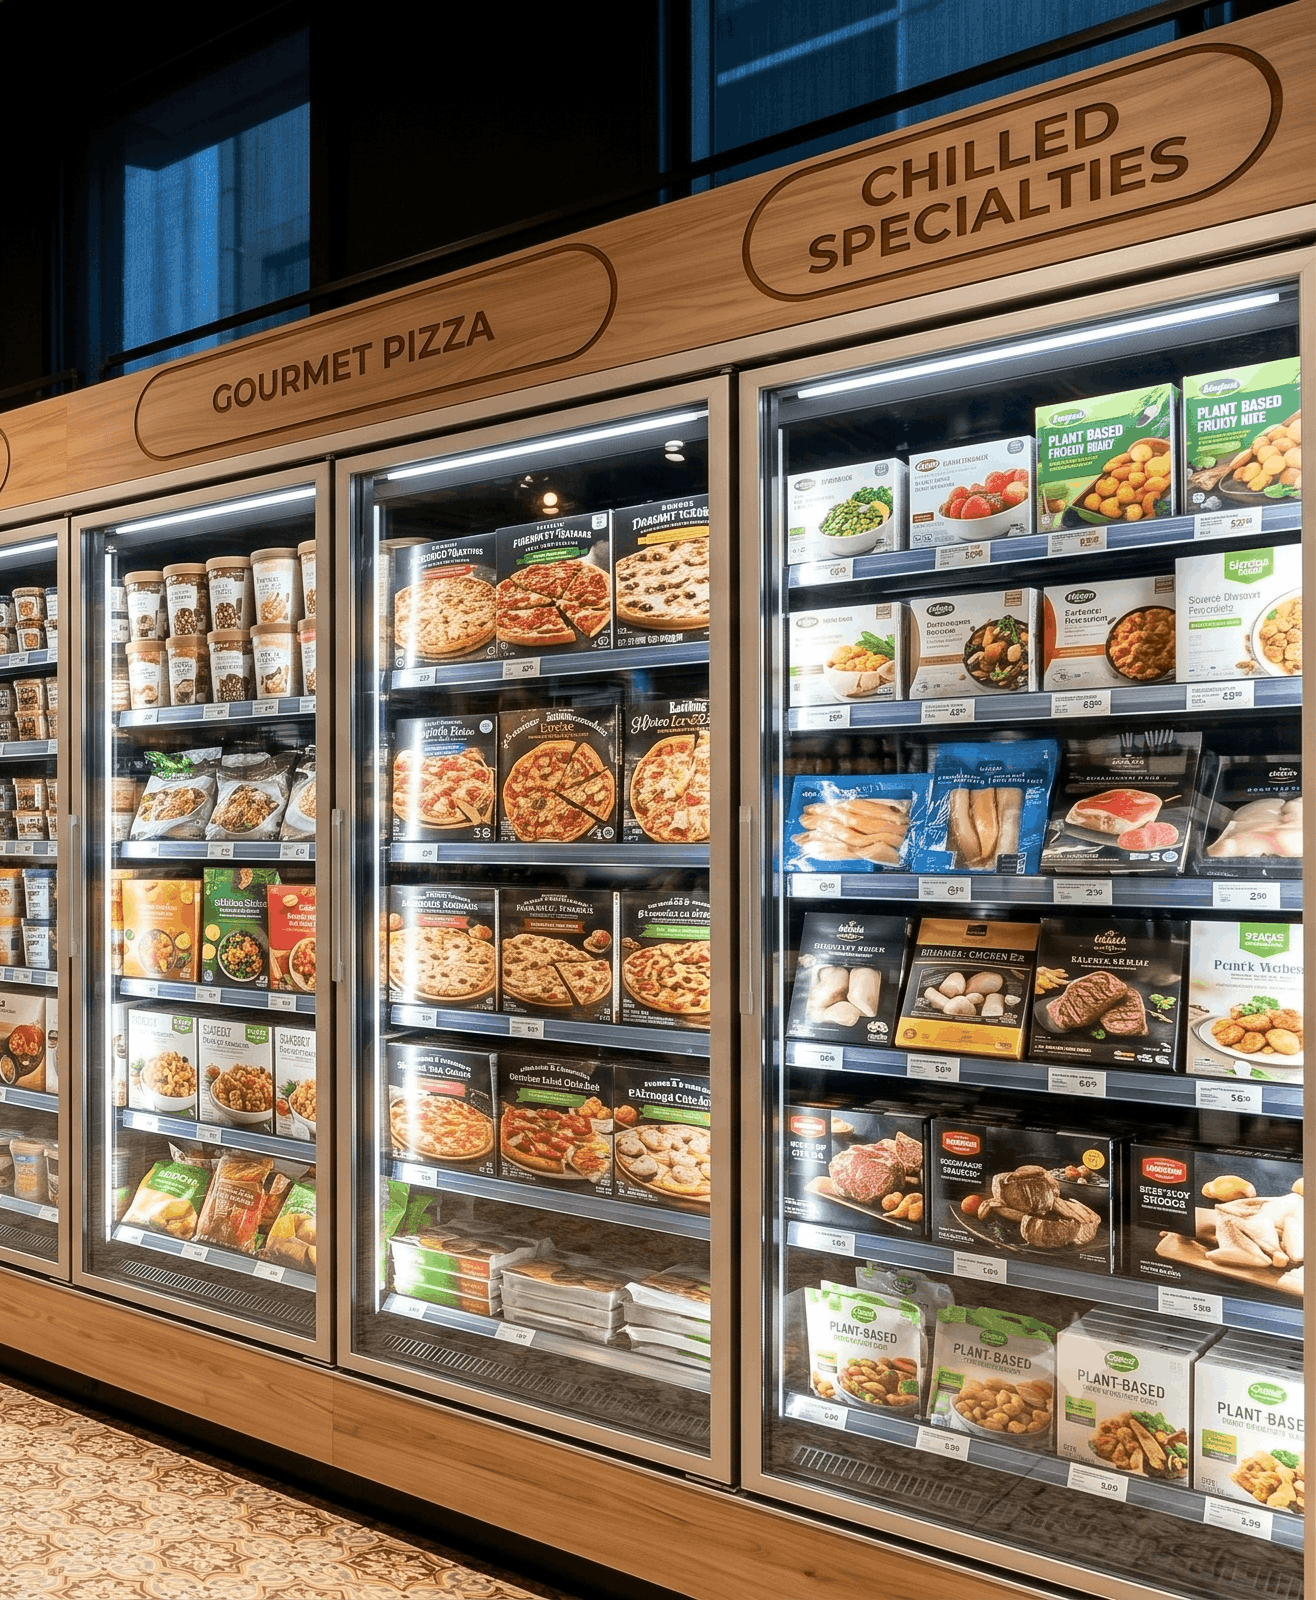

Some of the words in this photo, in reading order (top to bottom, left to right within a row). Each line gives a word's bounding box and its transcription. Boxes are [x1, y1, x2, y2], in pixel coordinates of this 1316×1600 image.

[861, 102, 1120, 207] CHILLED
[808, 136, 1190, 275] SPECIALTIES
[212, 341, 374, 414] GOURMET
[384, 310, 496, 369] PIZZA
[1197, 402, 1238, 420] PLANT
[1241, 394, 1283, 413] BASED
[1048, 431, 1085, 448] PLANT
[1087, 423, 1124, 441] BASED
[953, 1343, 1032, 1370] PLANT-BASED
[1077, 1368, 1166, 1399] PLANT-BASED
